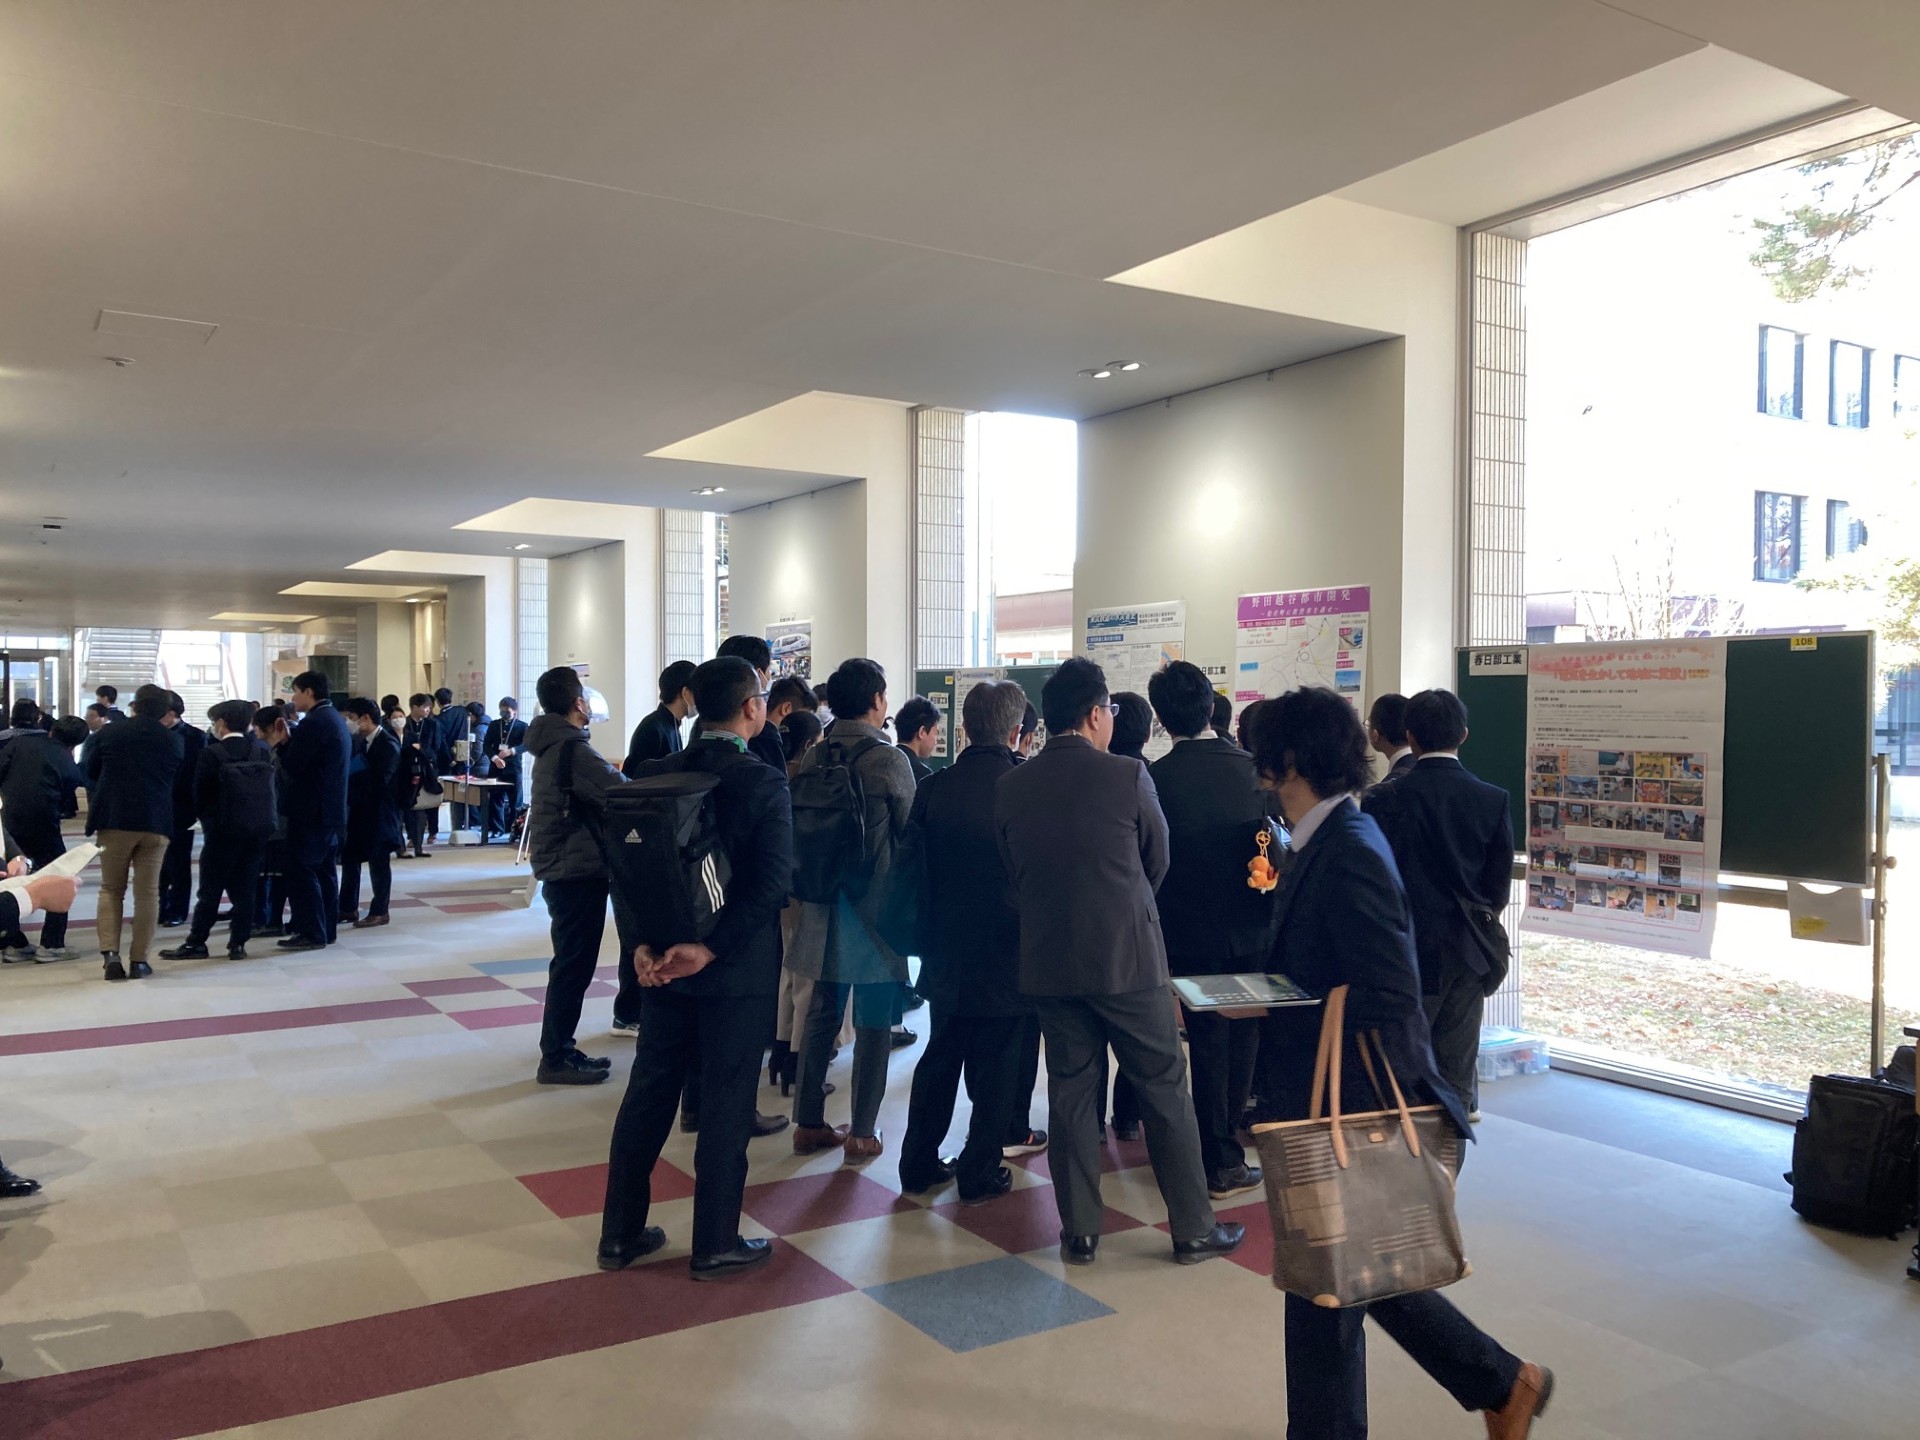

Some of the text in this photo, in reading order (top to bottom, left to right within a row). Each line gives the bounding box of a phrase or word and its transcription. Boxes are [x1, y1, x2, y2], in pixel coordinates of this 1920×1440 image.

[1251, 590, 1351, 608] 野田越谷都市開発
[1796, 638, 1813, 646] 108
[1474, 654, 1522, 666] 春日部工業
[1198, 665, 1227, 675] 日部工業
